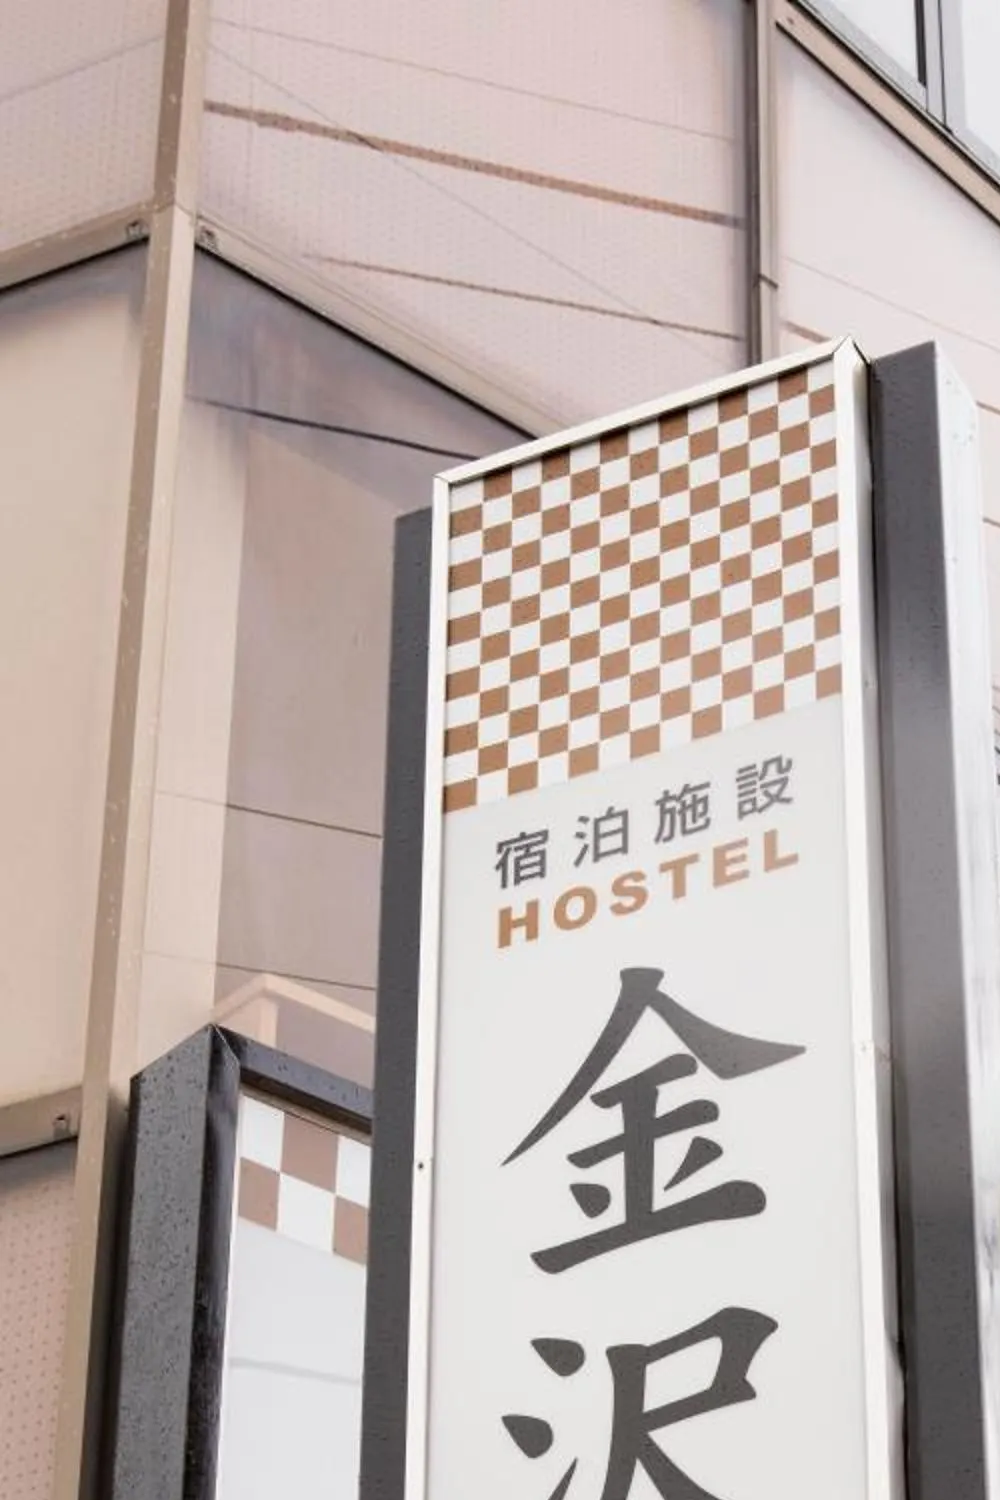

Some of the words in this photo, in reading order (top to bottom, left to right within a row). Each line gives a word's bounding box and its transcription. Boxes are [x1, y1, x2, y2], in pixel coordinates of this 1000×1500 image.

[494, 754, 794, 890] 宿泊施設
[497, 828, 800, 949] HOSTEL
